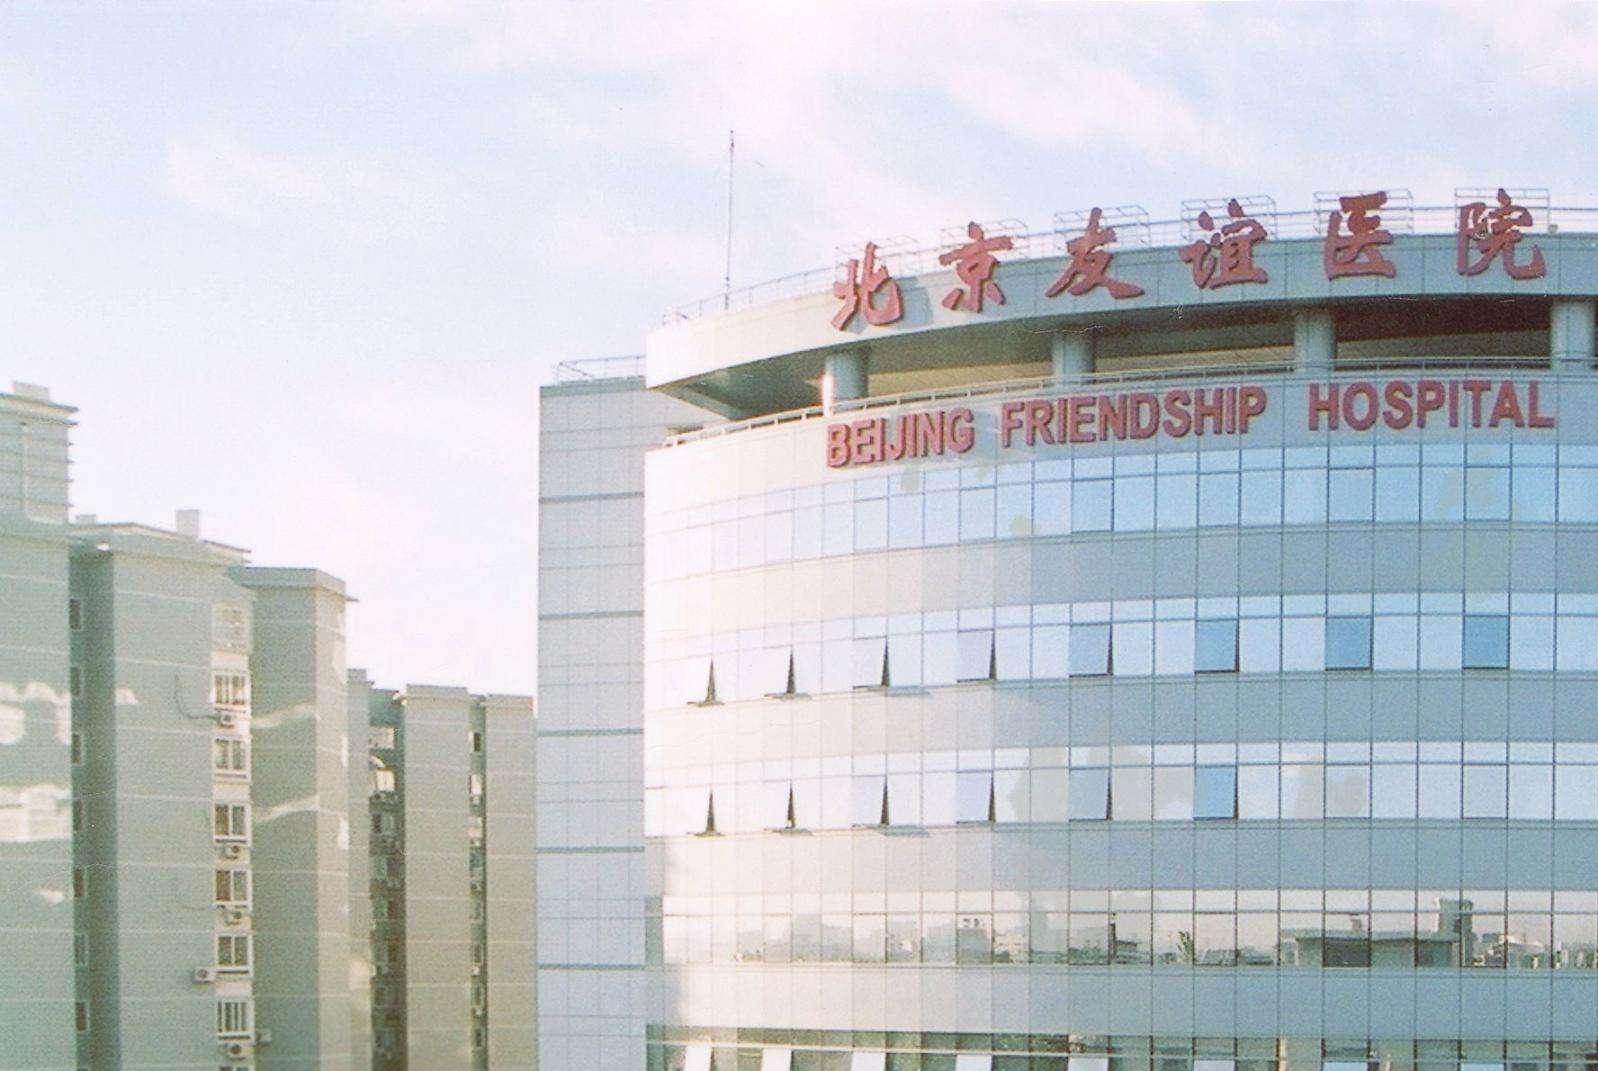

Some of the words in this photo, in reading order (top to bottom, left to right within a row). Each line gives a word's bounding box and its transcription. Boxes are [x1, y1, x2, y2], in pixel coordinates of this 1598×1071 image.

[832, 188, 1547, 331] 北京友谊医院
[827, 406, 975, 467] BEIJING
[1001, 385, 1267, 448] FRIENDSHIP
[1308, 379, 1555, 431] HOSPITAL
